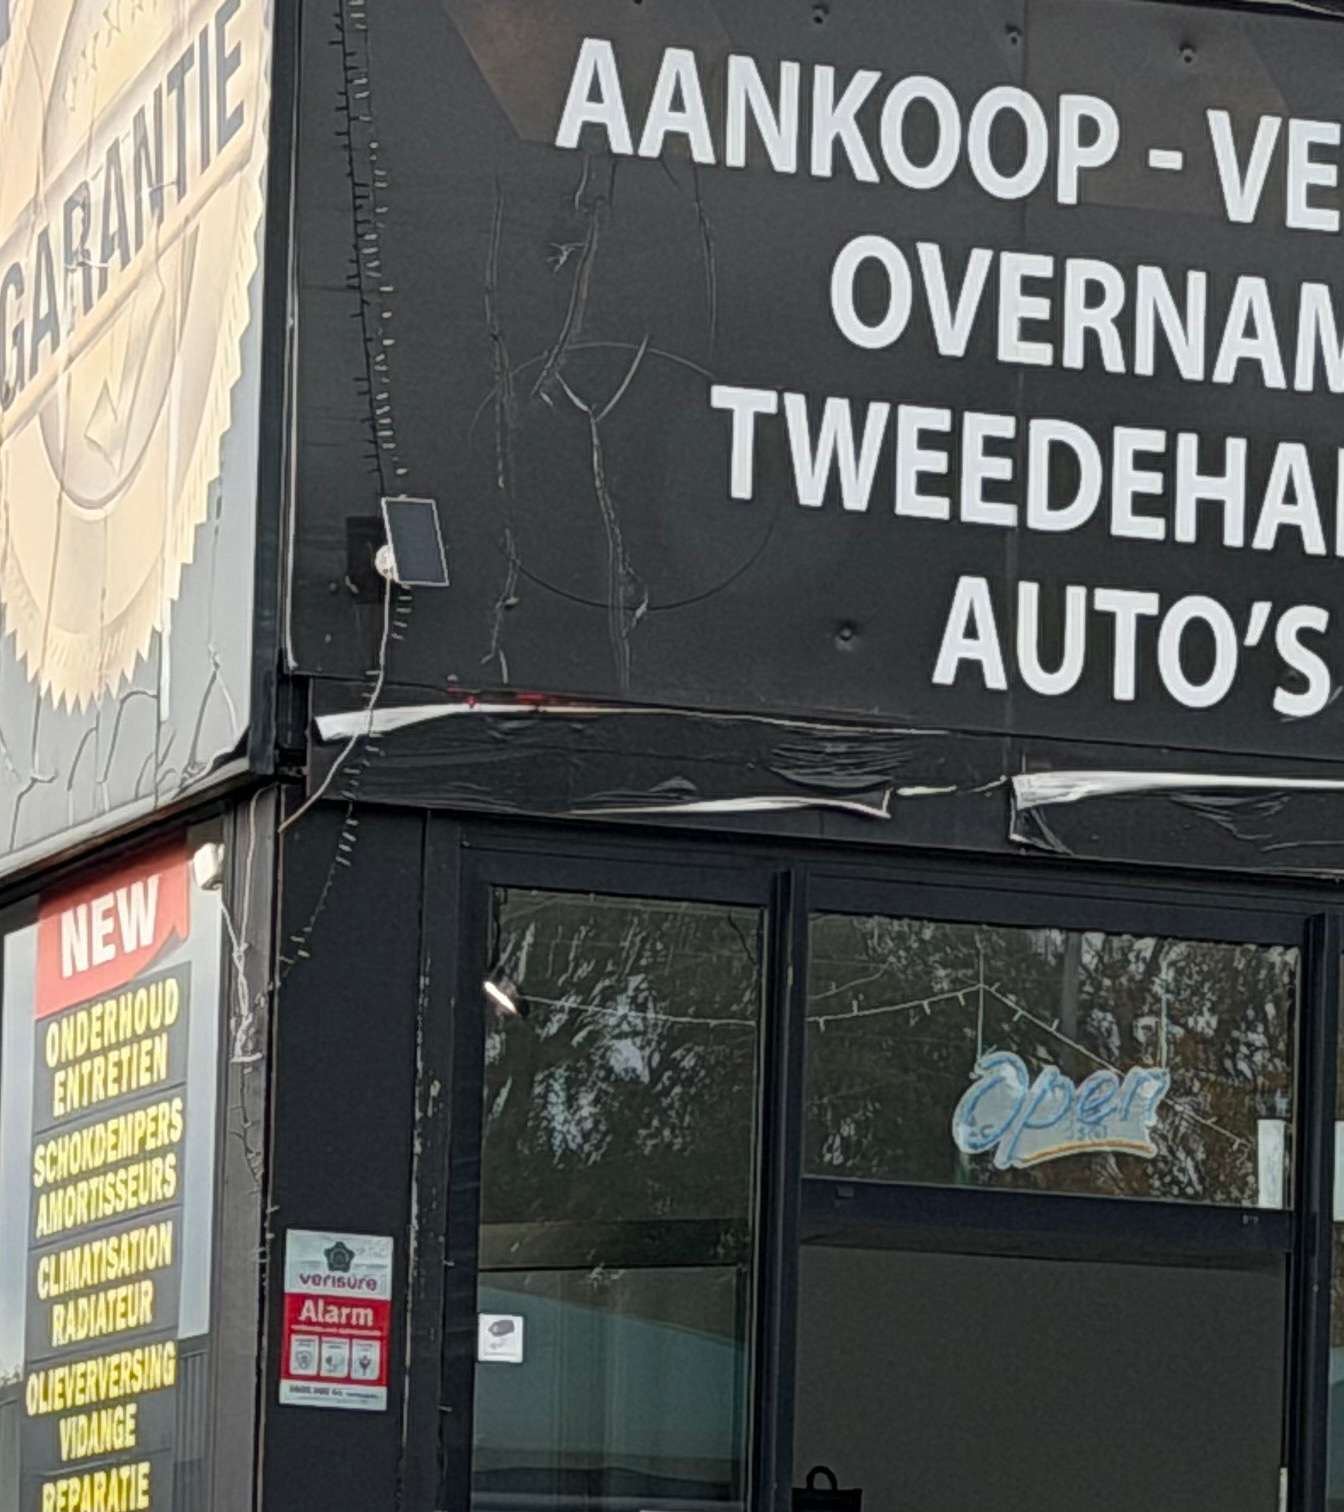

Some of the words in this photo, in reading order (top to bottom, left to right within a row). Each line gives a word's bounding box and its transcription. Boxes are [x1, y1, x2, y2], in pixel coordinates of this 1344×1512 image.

[554, 37, 1120, 206] AANKOOP
[60, 874, 159, 979] NEW
[46, 978, 179, 1068] ONDERHOUD
[53, 1033, 168, 1117] ENTRETIEN
[956, 1053, 1169, 1164] Open
[33, 1097, 183, 1188] SCHOKDEMPERS
[36, 1153, 177, 1239] AMORTISSEURS
[37, 1221, 173, 1300] CLIMATISATION
[299, 1273, 377, 1292] verisure
[52, 1280, 154, 1347] RADIATEUR
[299, 1299, 374, 1327] Alarm
[26, 1341, 176, 1416] OLIEVERVERSING
[59, 1403, 137, 1461] VIDANGE
